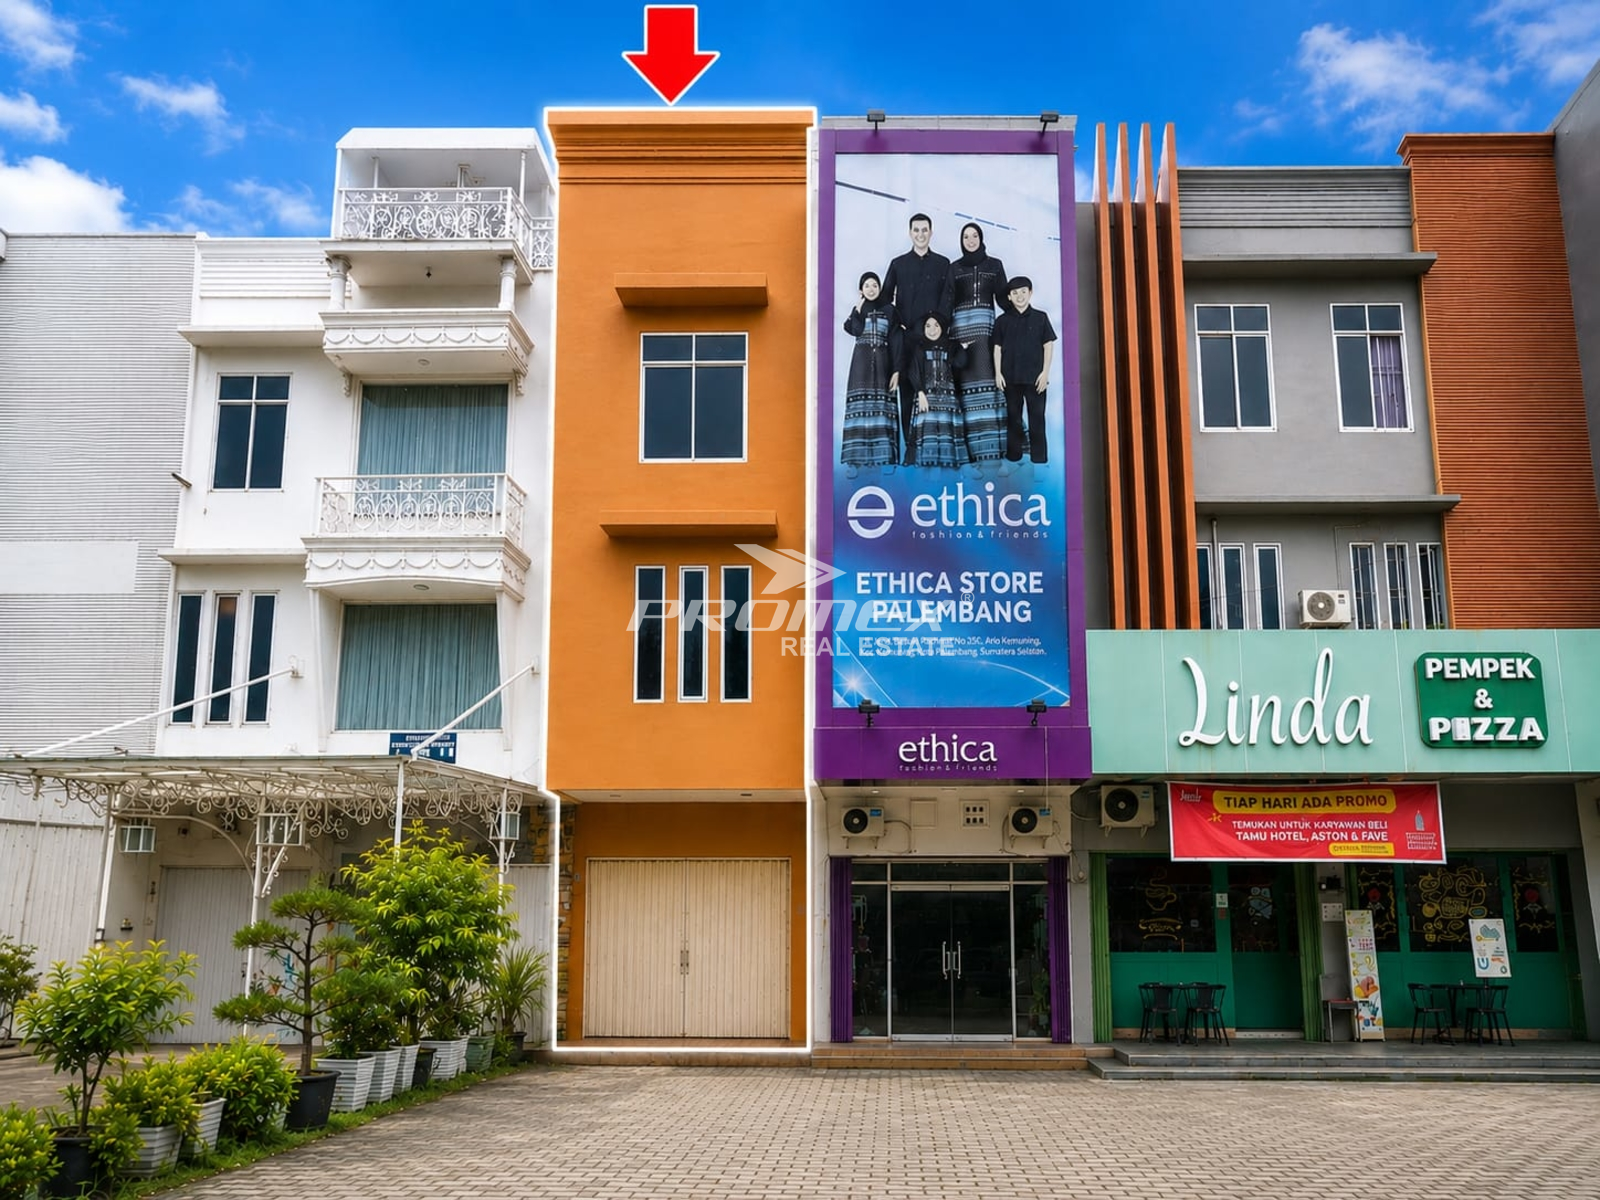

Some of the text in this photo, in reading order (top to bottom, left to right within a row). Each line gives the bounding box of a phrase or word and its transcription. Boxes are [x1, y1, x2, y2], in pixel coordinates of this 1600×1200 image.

[910, 481, 1052, 527] ethica
[990, 530, 1048, 539] friends
[856, 571, 1044, 594] ETHICA STORE
[872, 600, 1032, 623] PALEMBANG
[1425, 658, 1536, 679] PEMPEK
[1178, 647, 1373, 746] Linda
[1474, 688, 1494, 709] &
[1428, 717, 1545, 741] PIZZA
[898, 733, 998, 762] ethica
[1224, 795, 1388, 810] TIAP HARI ADA PROMO
[1232, 820, 1277, 830] TEMUKAN
[1279, 820, 1312, 830] UNTUK
[1313, 820, 1366, 830] KARYAWAN
[1236, 831, 1388, 843] TAMU HOTEL, ASTON & FAVE
